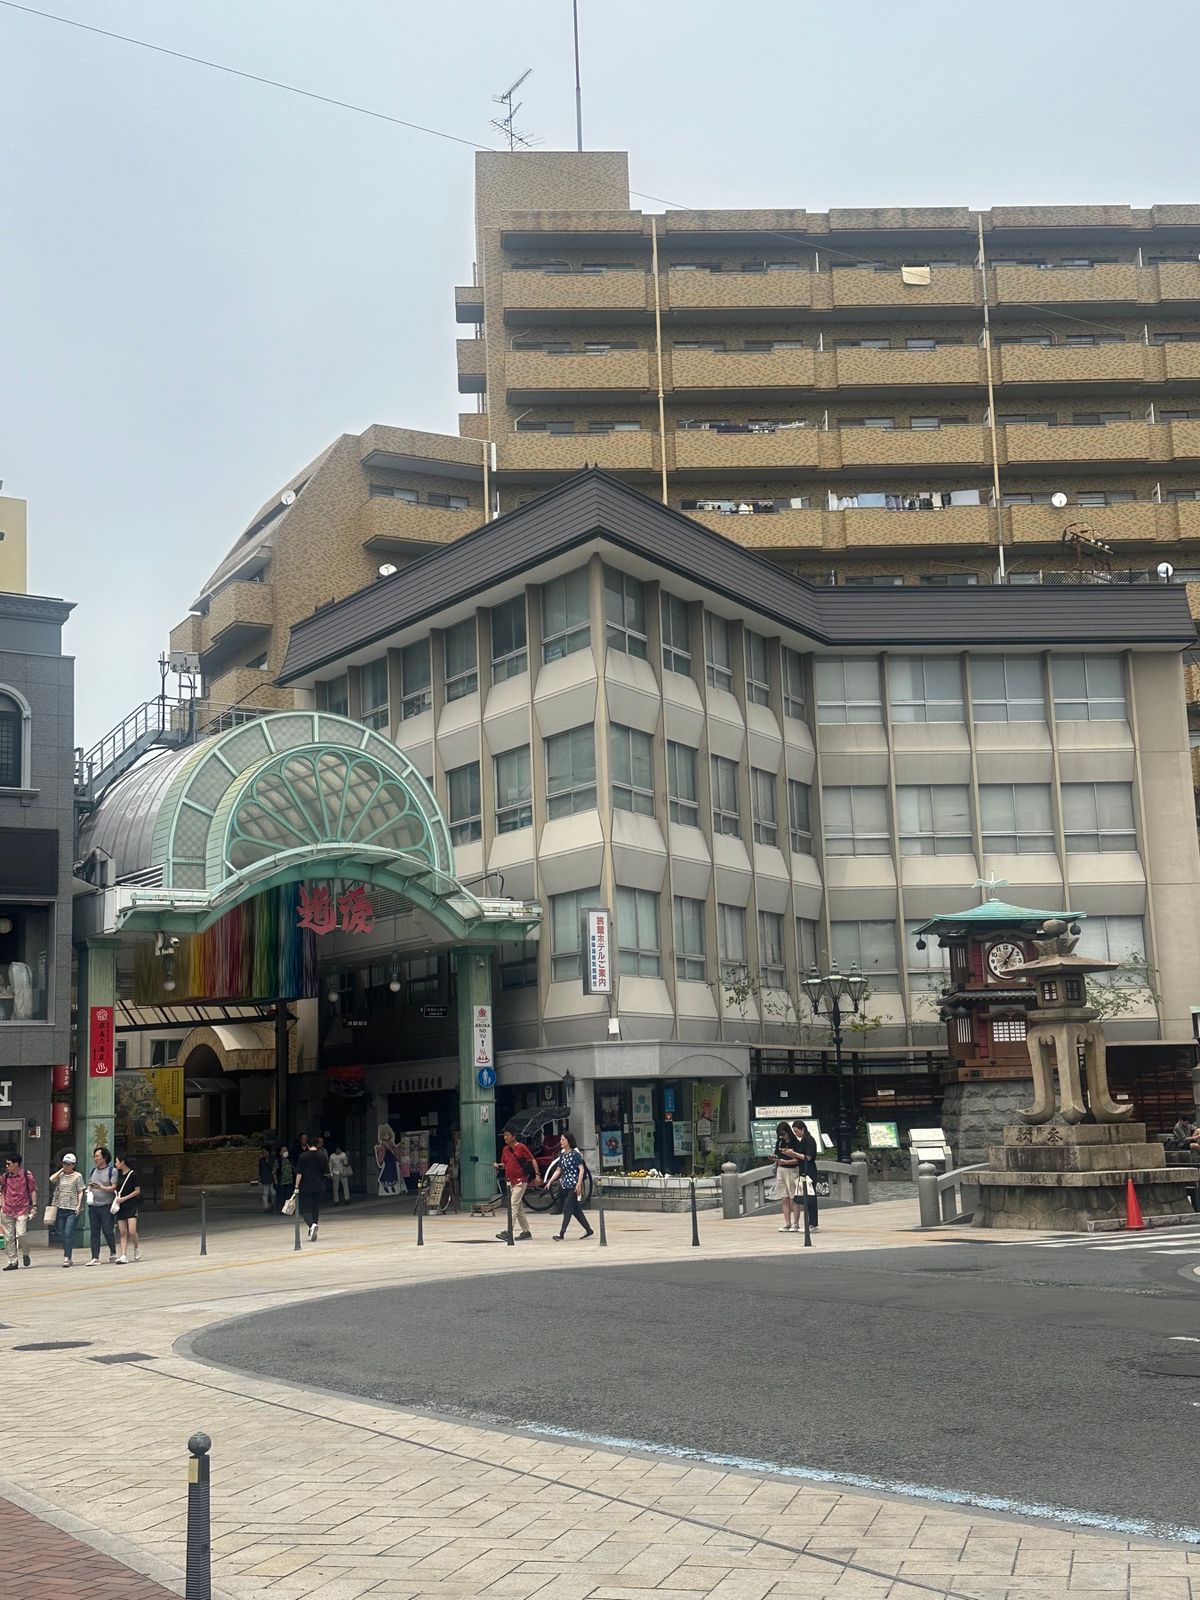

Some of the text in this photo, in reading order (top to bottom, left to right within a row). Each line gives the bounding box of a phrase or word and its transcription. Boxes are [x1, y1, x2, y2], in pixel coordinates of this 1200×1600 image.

[296, 884, 374, 935] 道後
[596, 916, 607, 987] 旅館ホテルご案内
